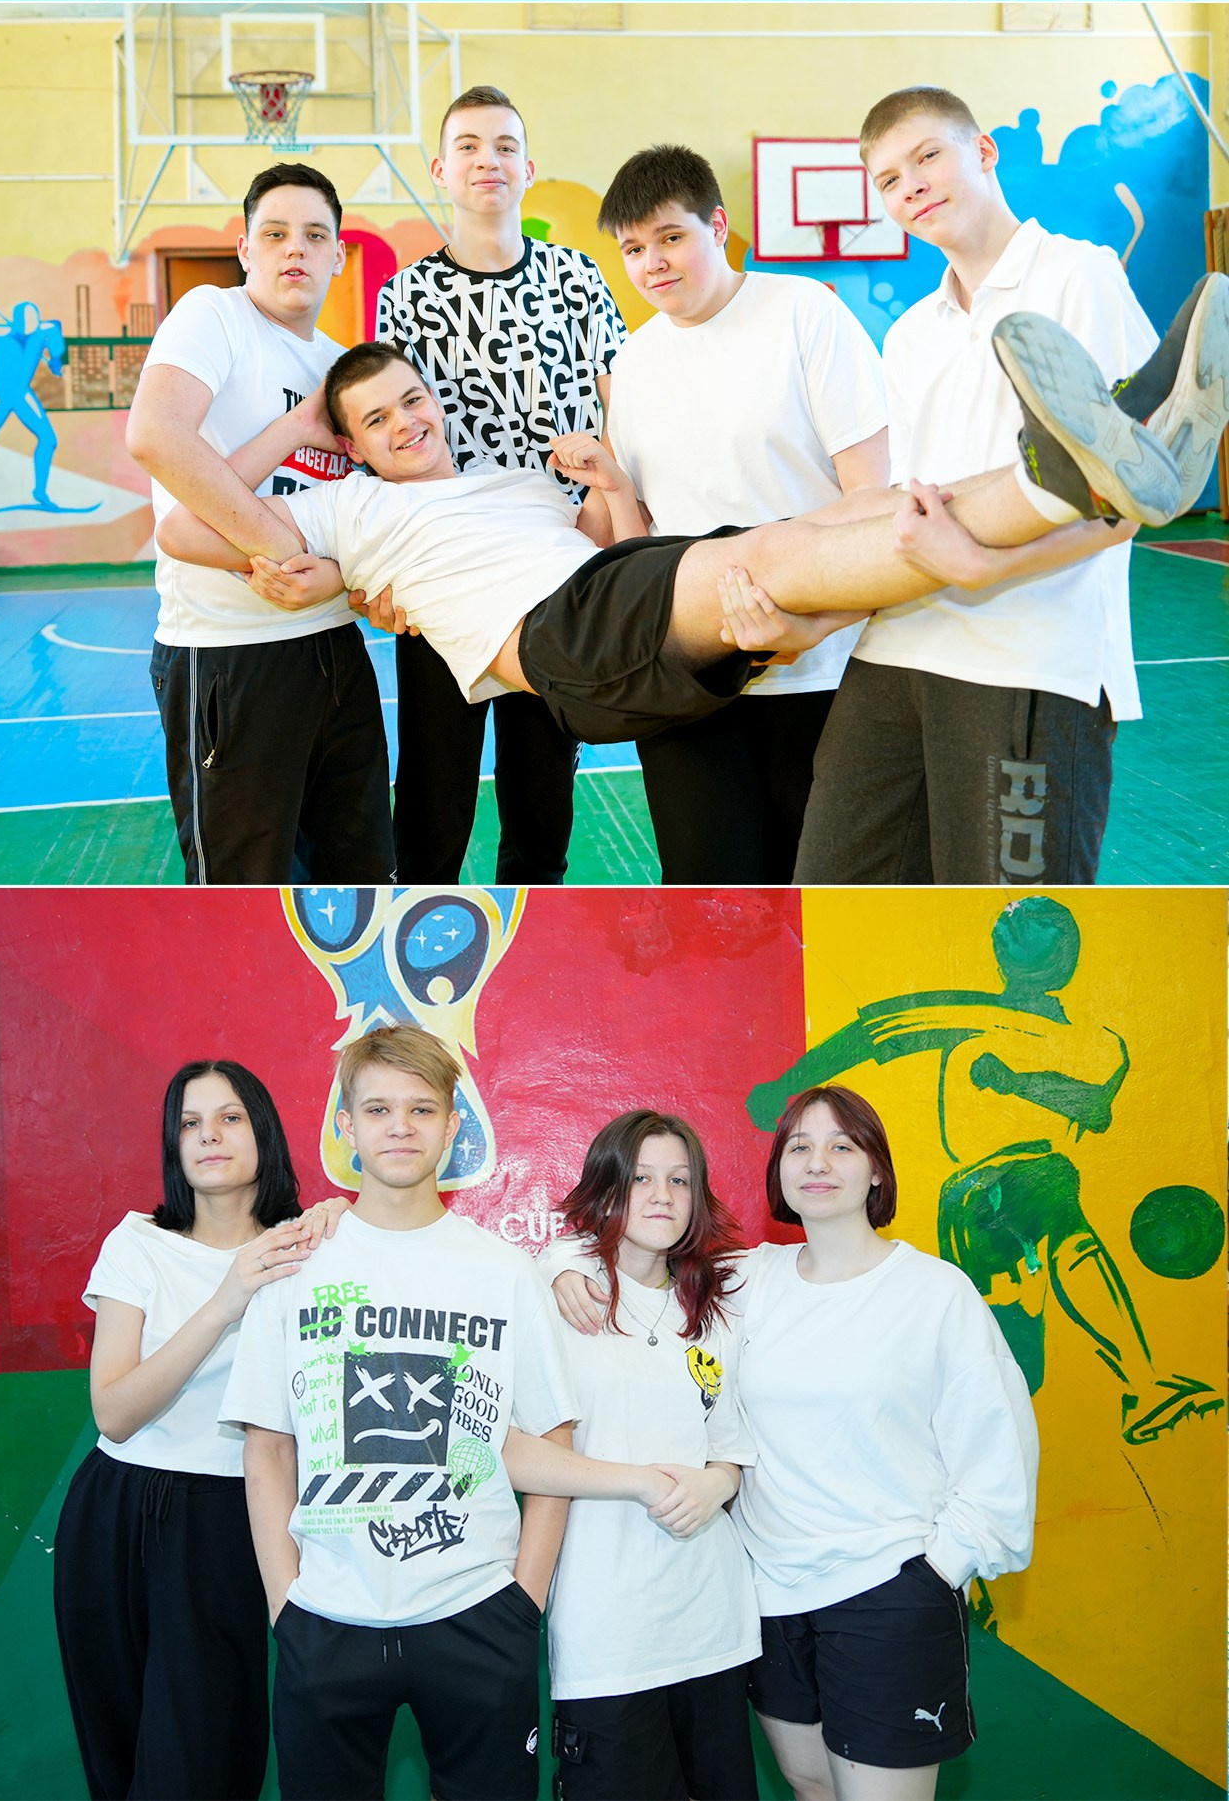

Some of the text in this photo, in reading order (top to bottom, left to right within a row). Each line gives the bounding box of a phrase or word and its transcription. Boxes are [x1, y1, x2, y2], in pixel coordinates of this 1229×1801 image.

[311, 1281, 372, 1309] FREE
[299, 1305, 508, 1351] NO CONNECT
[461, 1364, 504, 1402] ONLY
[452, 1385, 499, 1424] GOOD
